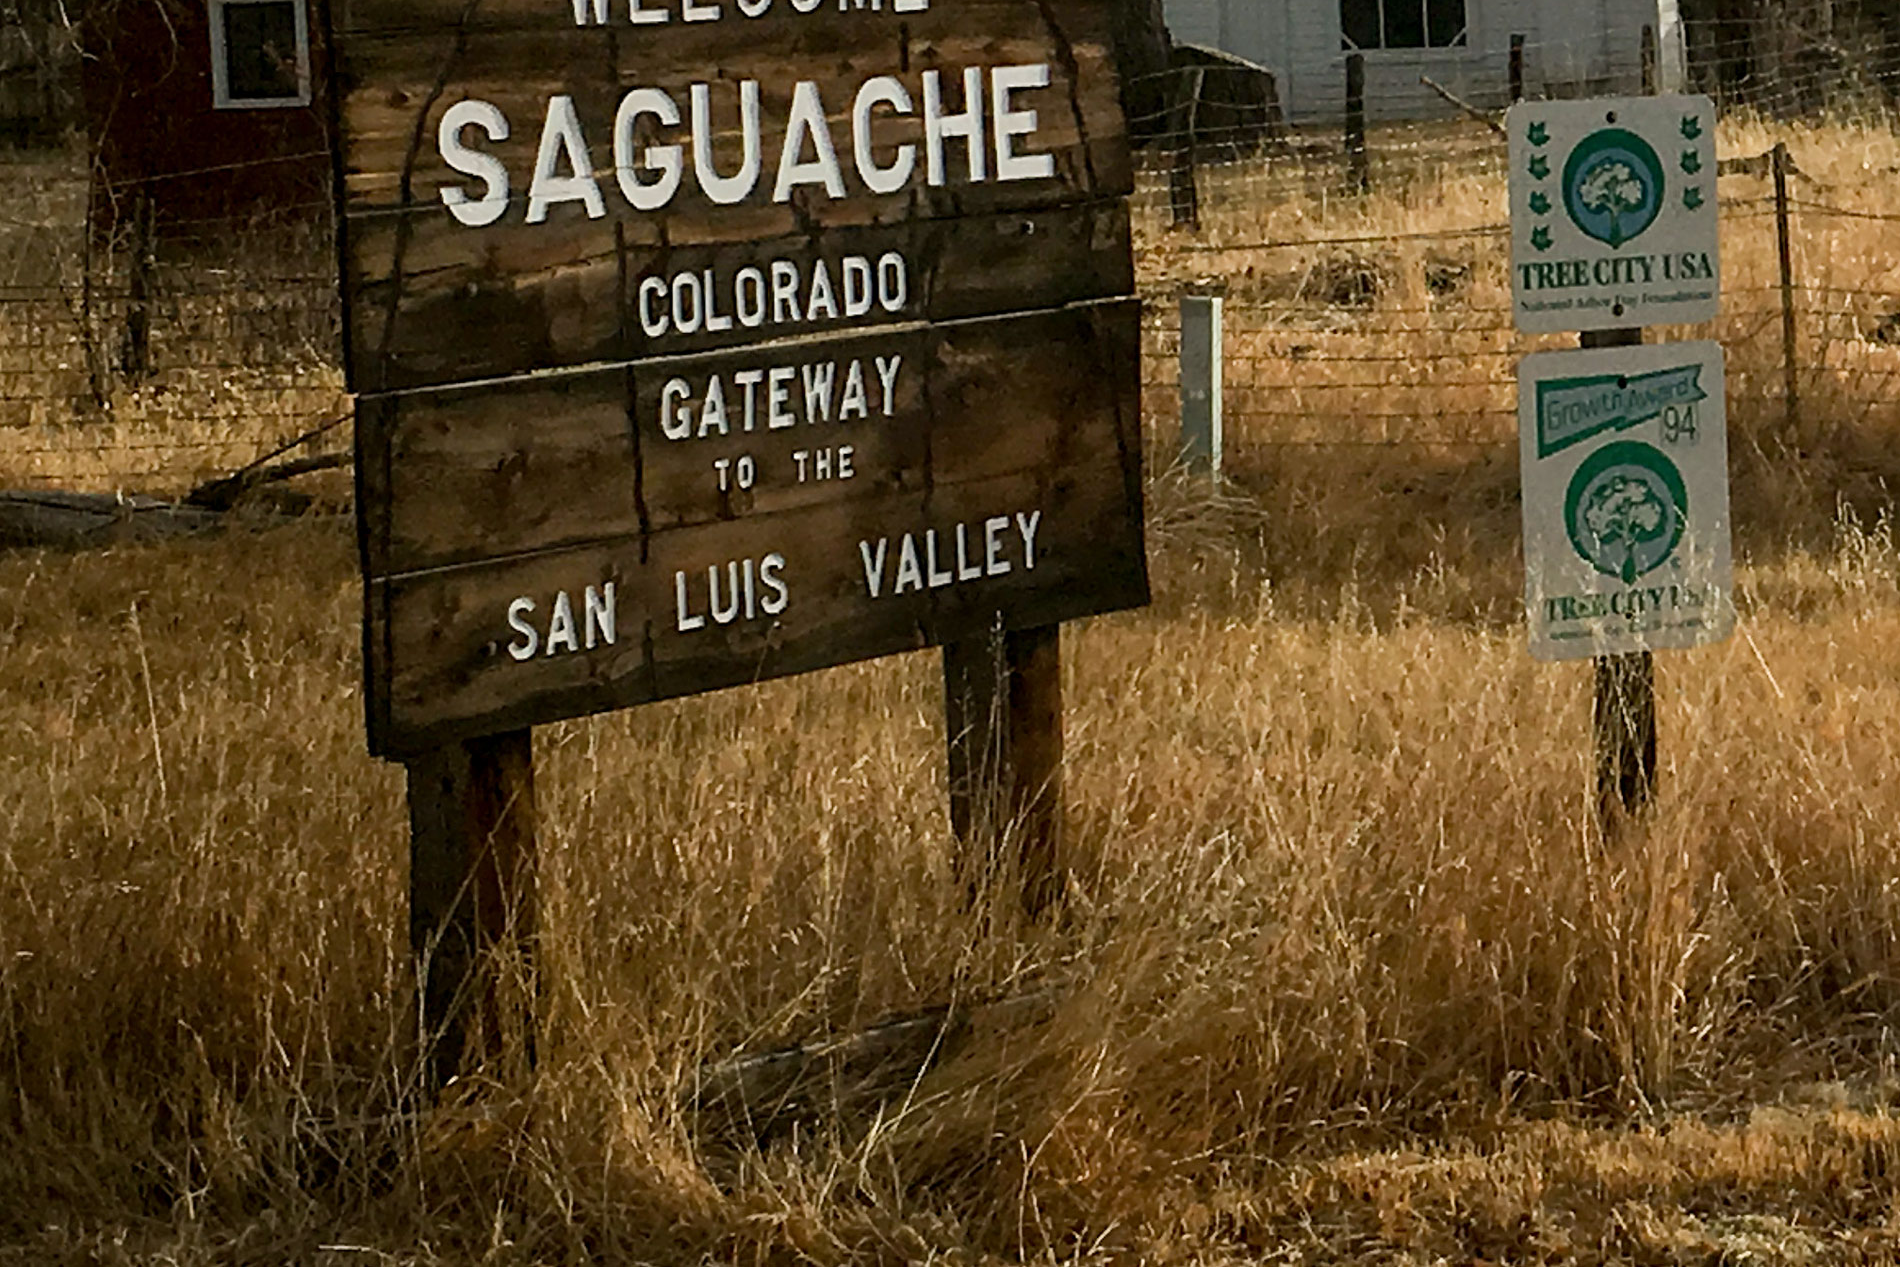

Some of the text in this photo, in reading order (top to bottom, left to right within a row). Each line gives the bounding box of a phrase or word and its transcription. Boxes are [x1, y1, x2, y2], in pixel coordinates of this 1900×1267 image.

[438, 63, 1054, 227] SAGUACHE
[639, 252, 906, 338] COLORADO
[1518, 252, 1713, 290] TREE CITY USA
[660, 355, 902, 440] GATEWAY
[1547, 377, 1689, 431] Growth Award
[1663, 405, 1696, 443] 94
[714, 445, 855, 491] TO THE
[507, 509, 1042, 662] SAN LUIS VALLEY
